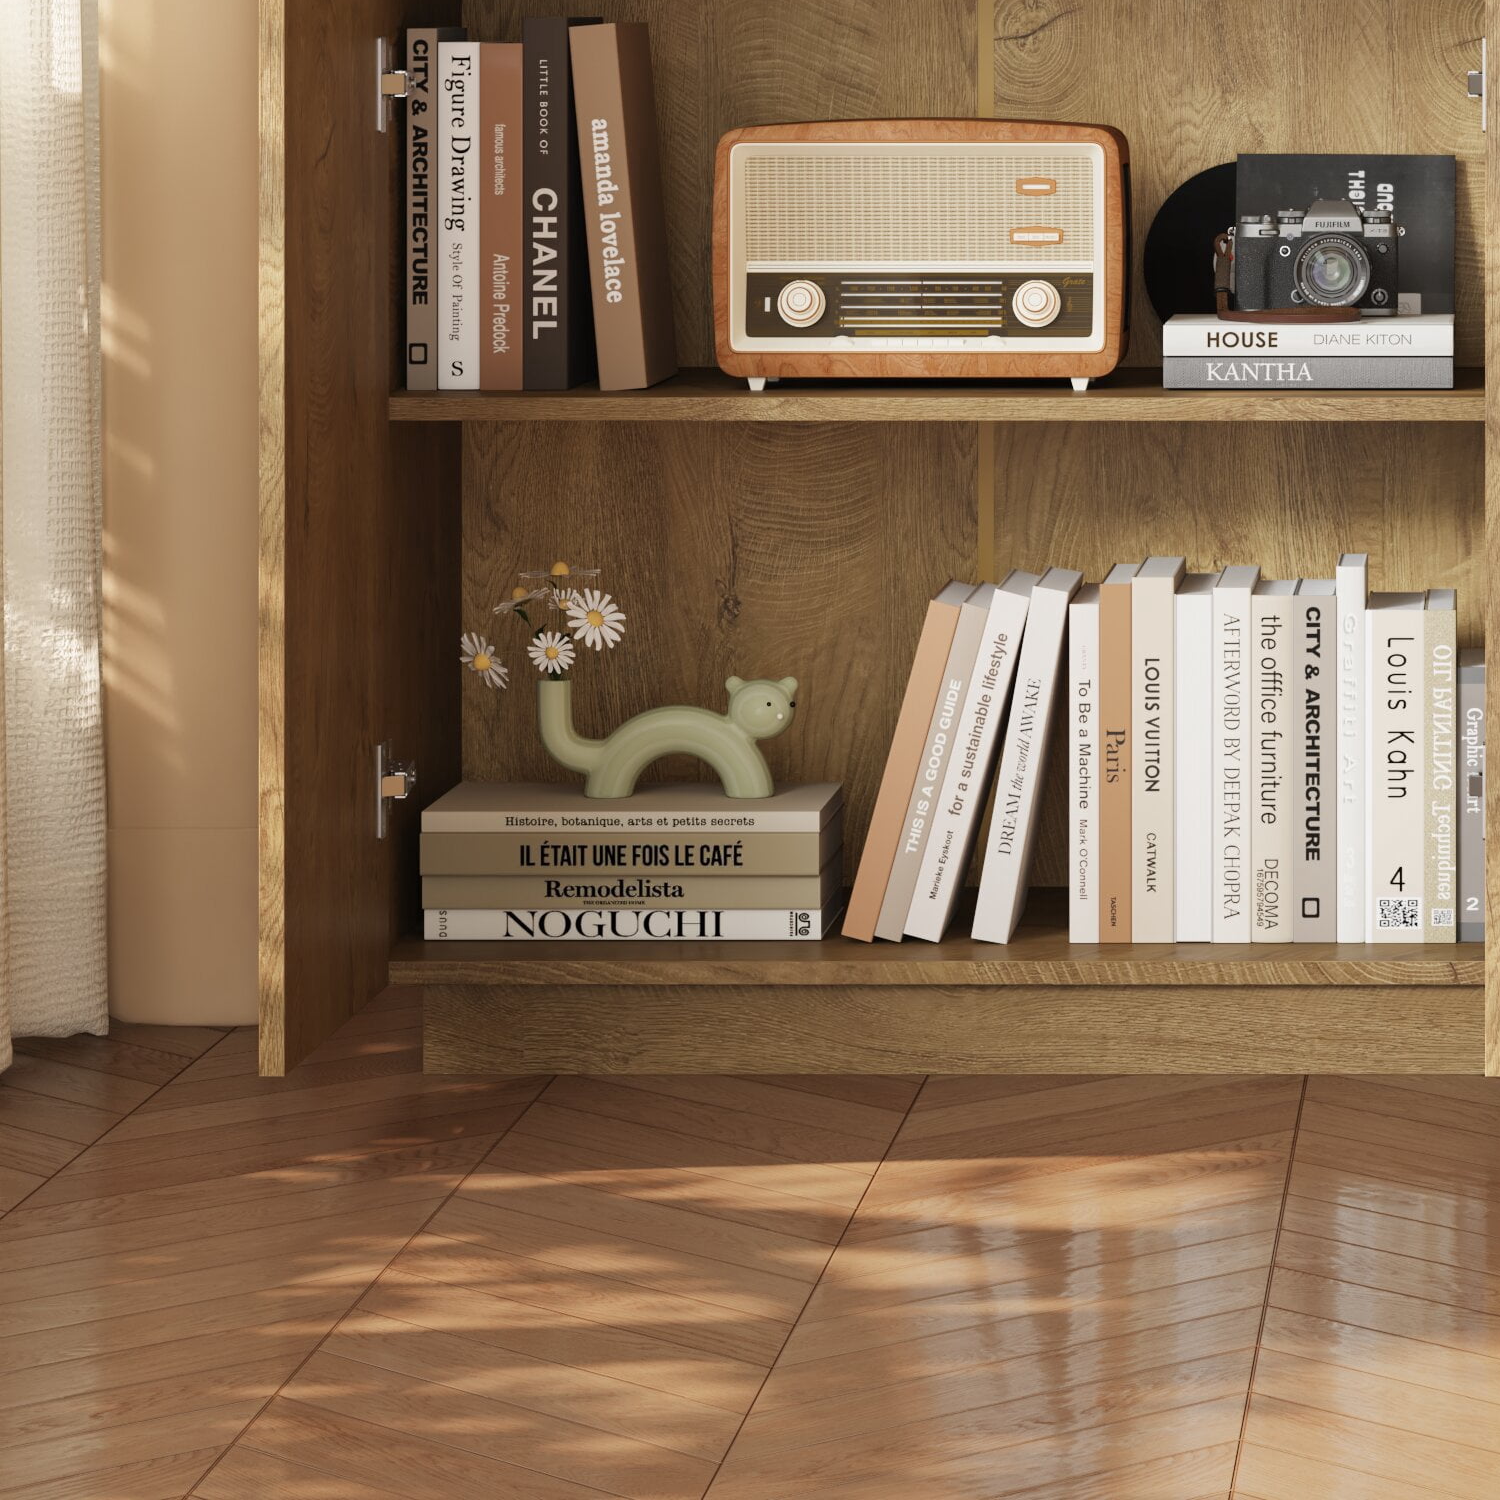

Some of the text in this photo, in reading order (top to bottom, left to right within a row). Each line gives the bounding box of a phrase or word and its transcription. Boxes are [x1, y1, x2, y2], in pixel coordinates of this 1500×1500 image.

[539, 59, 548, 156] LITTLE BOOK OF
[412, 39, 429, 305] CITY & ARCHITECTURE
[494, 124, 506, 196] famous architects
[444, 55, 472, 377] Figure Drawing Style Of Painting S
[591, 118, 625, 303] amanda lovelace
[532, 188, 558, 340] CHANEL
[493, 253, 510, 354] Antoine Predock
[1207, 332, 1412, 348] HOUSE DIANE KITON
[1206, 363, 1313, 382] KANTHA
[1261, 615, 1283, 650] the
[1078, 679, 1091, 697] To
[1078, 703, 1090, 725] Be
[1342, 614, 1356, 804] Graffiti Art
[1387, 636, 1414, 799] Louis Kahn
[1079, 728, 1088, 738] a
[1106, 729, 1126, 784] Paris
[1145, 658, 1160, 792] LOUIS VUITTON
[1305, 606, 1320, 861] CITY & ARCHITECTURE
[1461, 707, 1483, 767] Graphic
[905, 678, 963, 854] THIS IS A GOOD GUIDE
[929, 632, 1008, 900] Marieke Eyskoot for a sustainable lifestyle
[998, 678, 1042, 855] DREAM the world AWAKE
[1079, 744, 1091, 809] Machine
[1223, 613, 1240, 920] AFTERWORD BY DEEPAK CHOPRA
[1261, 731, 1283, 825] furniture
[505, 816, 755, 828] Histoire, botanique, arts et petits secrets
[519, 840, 743, 867] IL ÉTAIT UNE FOIS LE CAFÉ
[1079, 819, 1088, 845] Mark
[544, 880, 685, 899] Remodelista
[1079, 848, 1088, 900] O'Connell
[1146, 832, 1157, 893] CATWALK
[1264, 858, 1279, 930] DECOMA
[1390, 866, 1405, 892] 4
[438, 910, 448, 938] DUUS
[502, 910, 725, 938] NOGUCHI
[1466, 898, 1478, 912] 2
